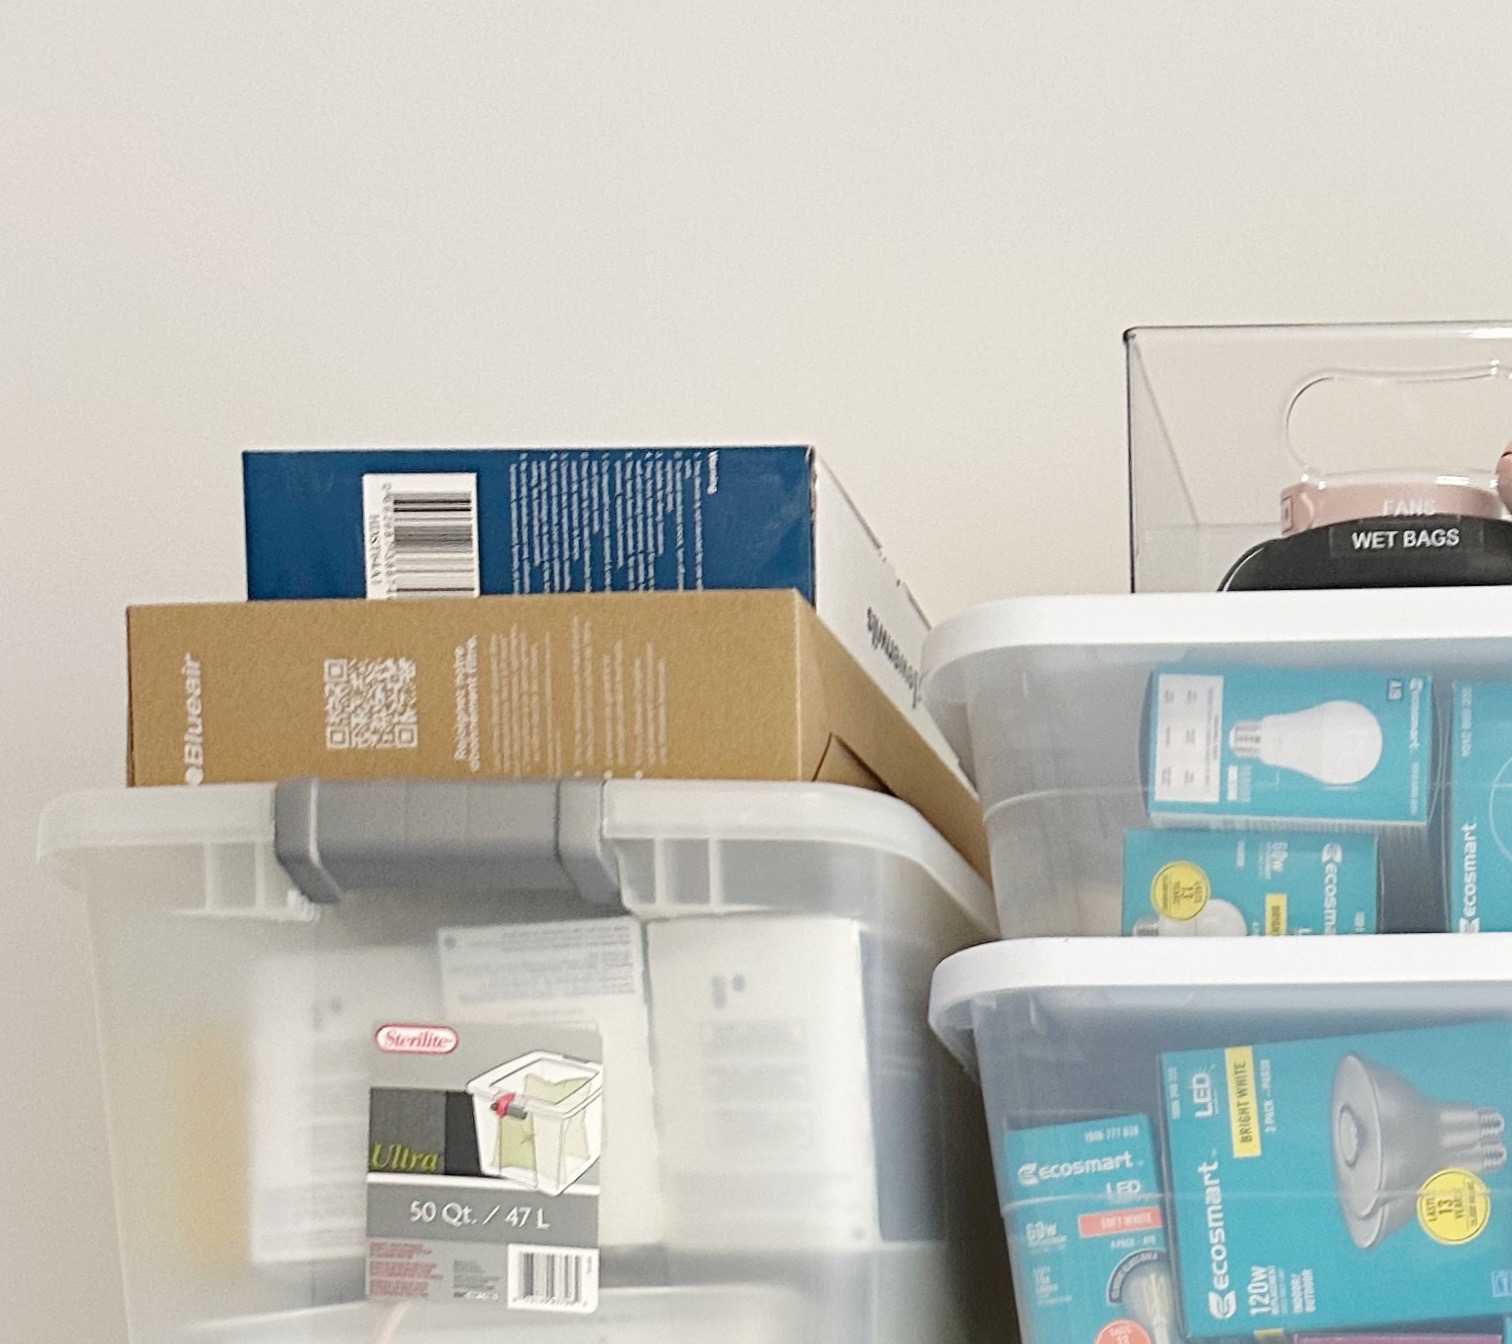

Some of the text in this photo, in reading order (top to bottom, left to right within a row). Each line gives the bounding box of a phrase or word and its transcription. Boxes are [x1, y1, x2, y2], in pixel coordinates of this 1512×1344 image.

[1382, 497, 1437, 516] FANS
[1352, 528, 1460, 549] WET BAGS
[180, 652, 203, 766] Blueair
[1462, 823, 1478, 916] ecosmart
[385, 1029, 454, 1048] Sterilite
[1191, 1073, 1215, 1118] LED
[1233, 1061, 1254, 1143] BRIGHT WHITE
[371, 1143, 439, 1172] Ultra
[1039, 1151, 1133, 1181] ecosmart
[410, 1200, 550, 1228] 50 Qt. / 47 L
[1438, 1199, 1455, 1216] 13
[1198, 1161, 1230, 1290] ecosmart
[1247, 1266, 1271, 1316] 120w
